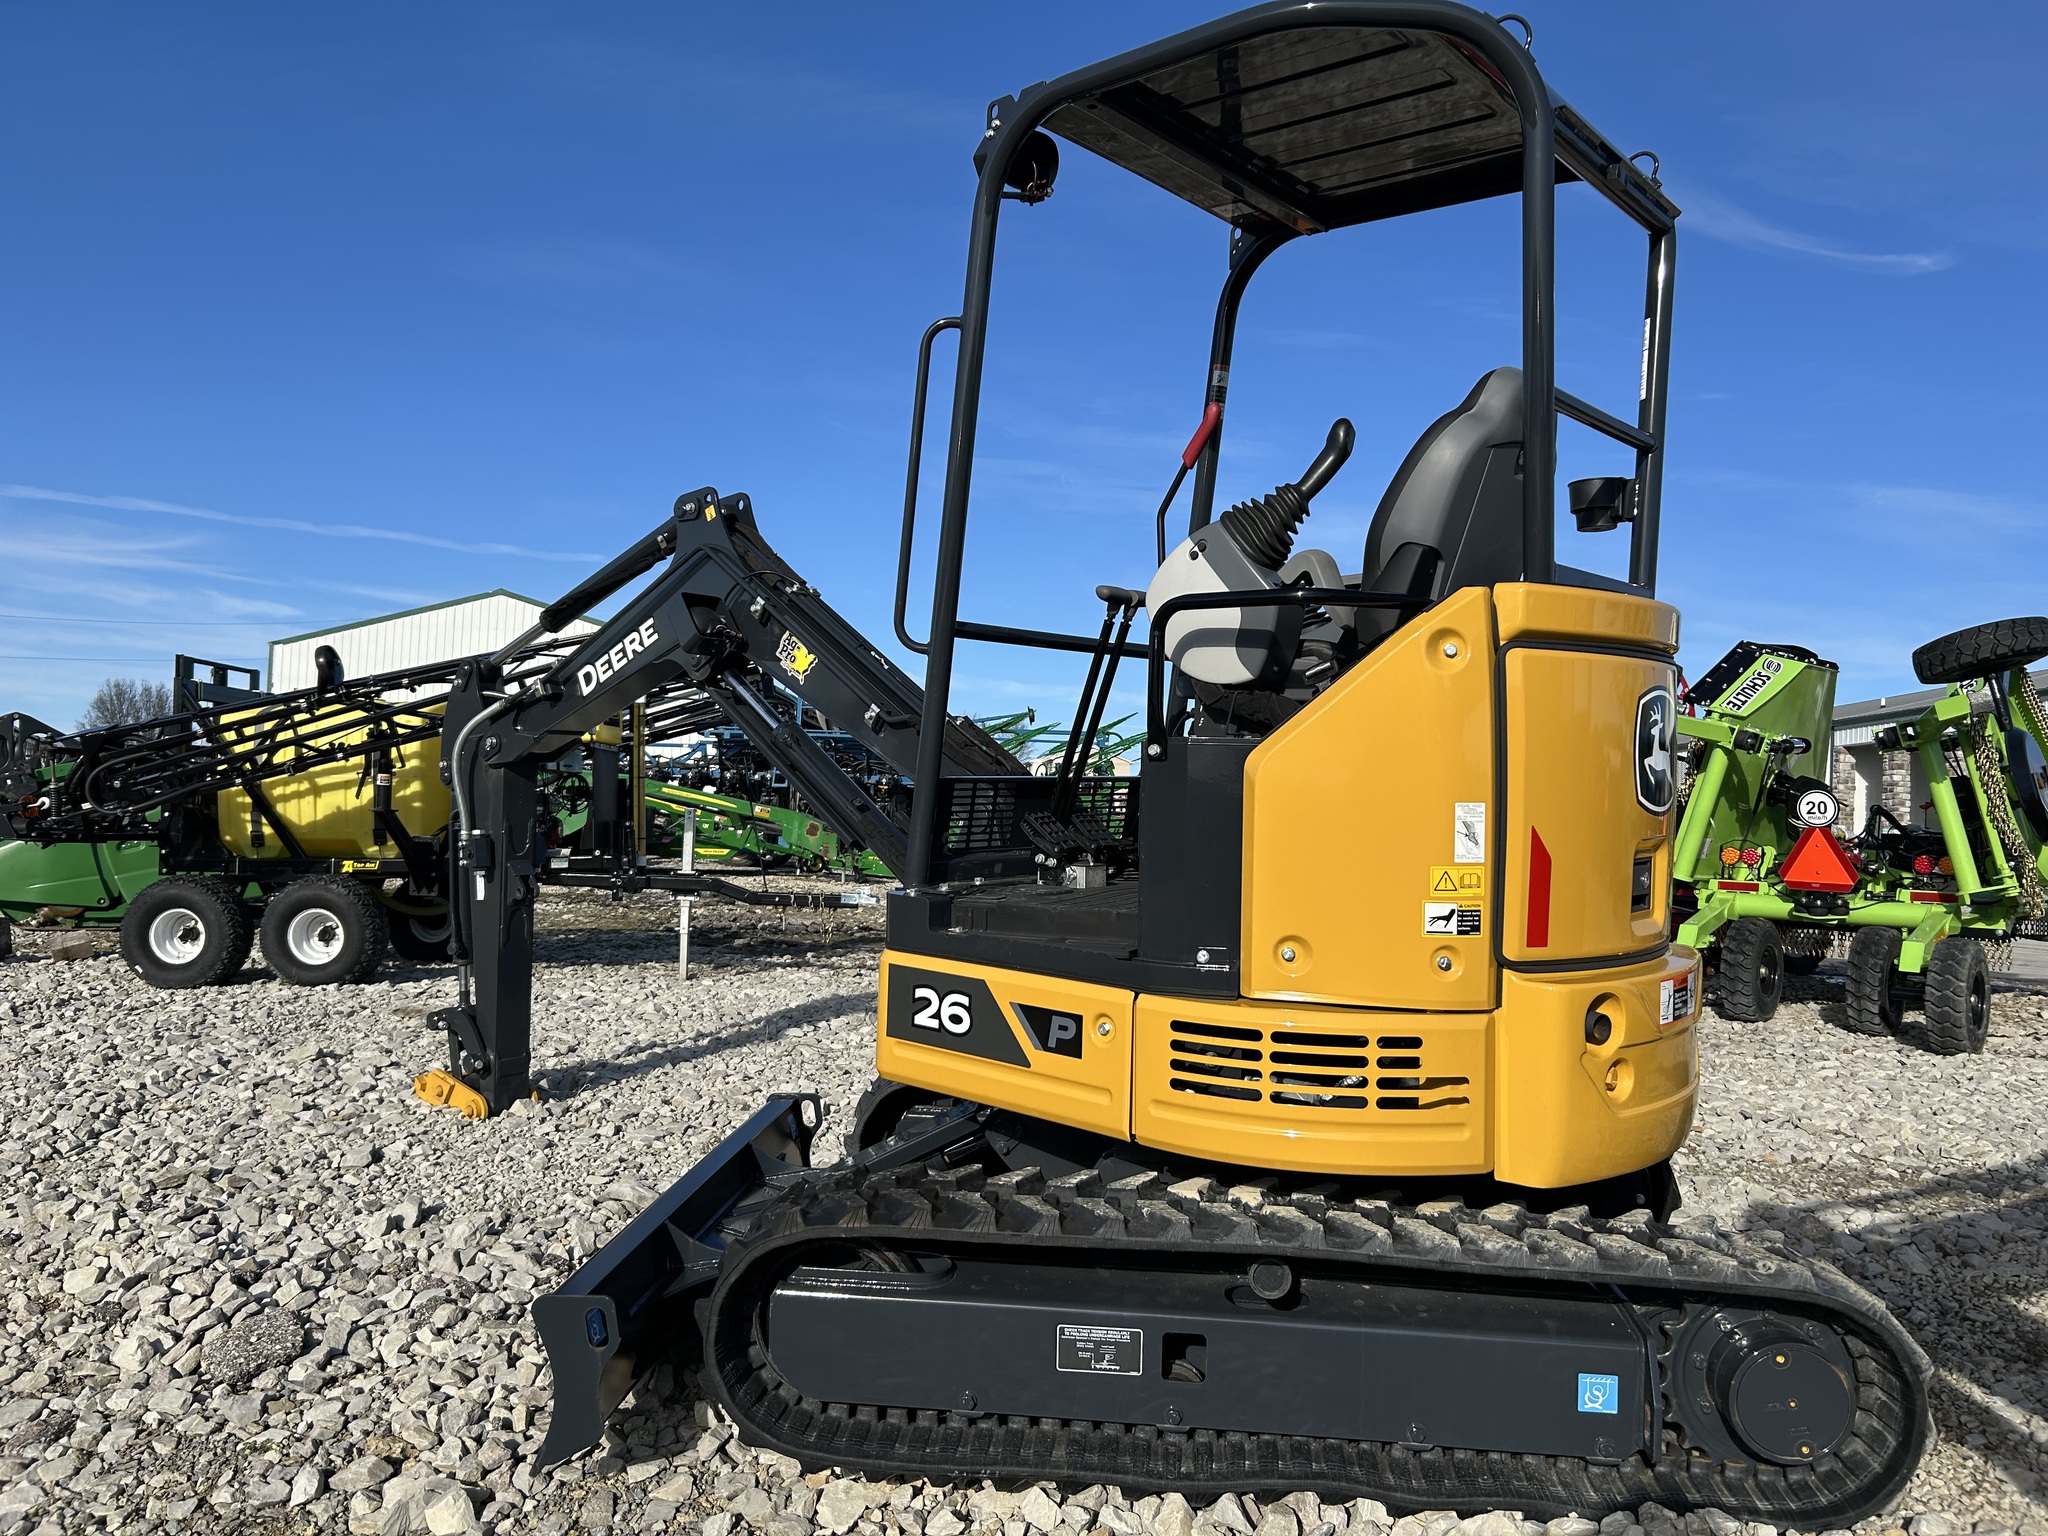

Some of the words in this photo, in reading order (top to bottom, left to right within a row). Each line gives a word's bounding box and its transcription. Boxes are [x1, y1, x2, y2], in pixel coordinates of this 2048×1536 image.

[577, 617, 659, 697] DEERE
[779, 644, 796, 663] Pro
[1726, 671, 1772, 711] SCHULTE
[1805, 801, 1828, 815] 20
[912, 986, 972, 1035] 26
[1047, 1015, 1077, 1049] P
